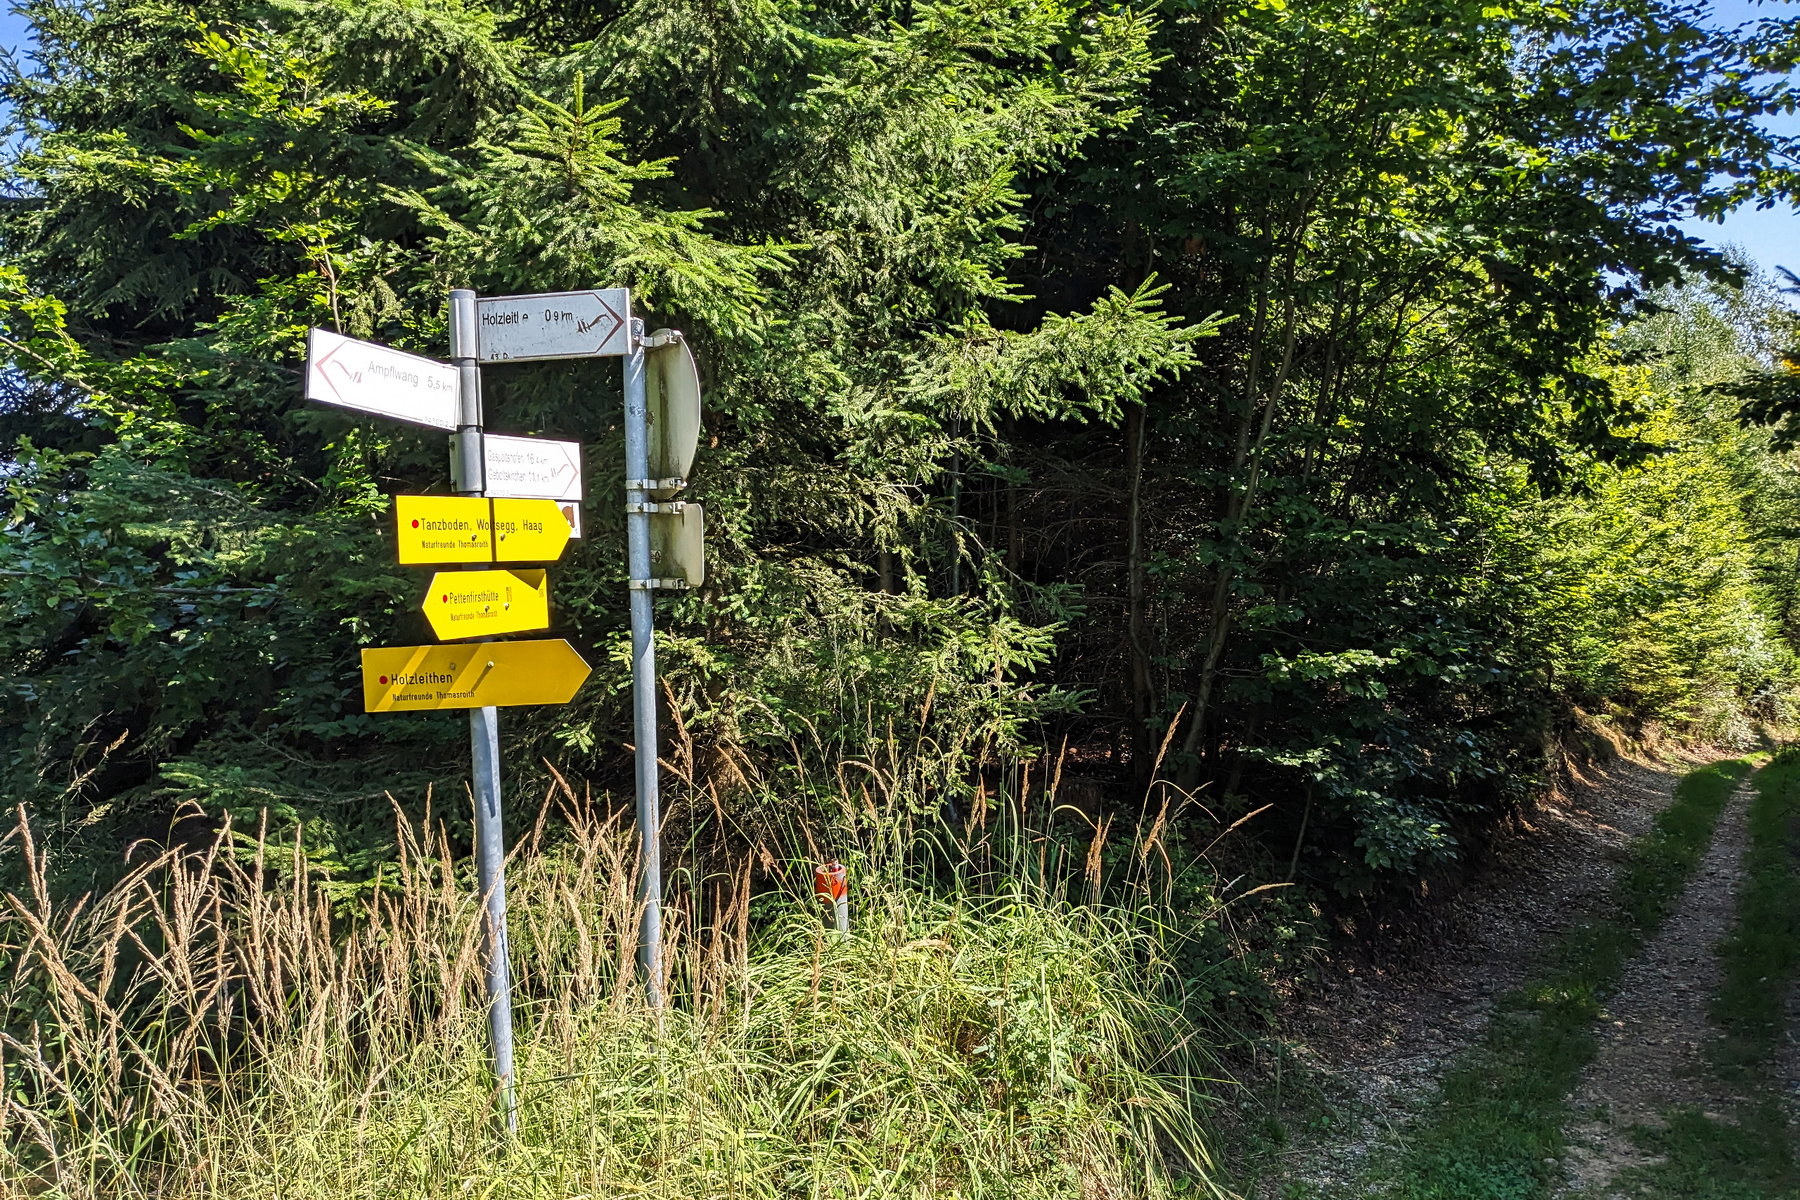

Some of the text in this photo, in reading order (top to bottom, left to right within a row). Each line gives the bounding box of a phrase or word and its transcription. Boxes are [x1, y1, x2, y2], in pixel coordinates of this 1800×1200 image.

[368, 361, 419, 387] Ampflwang
[427, 376, 441, 391] 5,5
[421, 518, 472, 532] Tanzboden,
[522, 519, 543, 534] Haag
[421, 539, 489, 549] Naturfreunde Thomasroith
[449, 590, 499, 604] Pettenfirsthütte
[391, 672, 453, 686] Holzleithen
[392, 690, 475, 702] Naturfreunde Thomasroith
